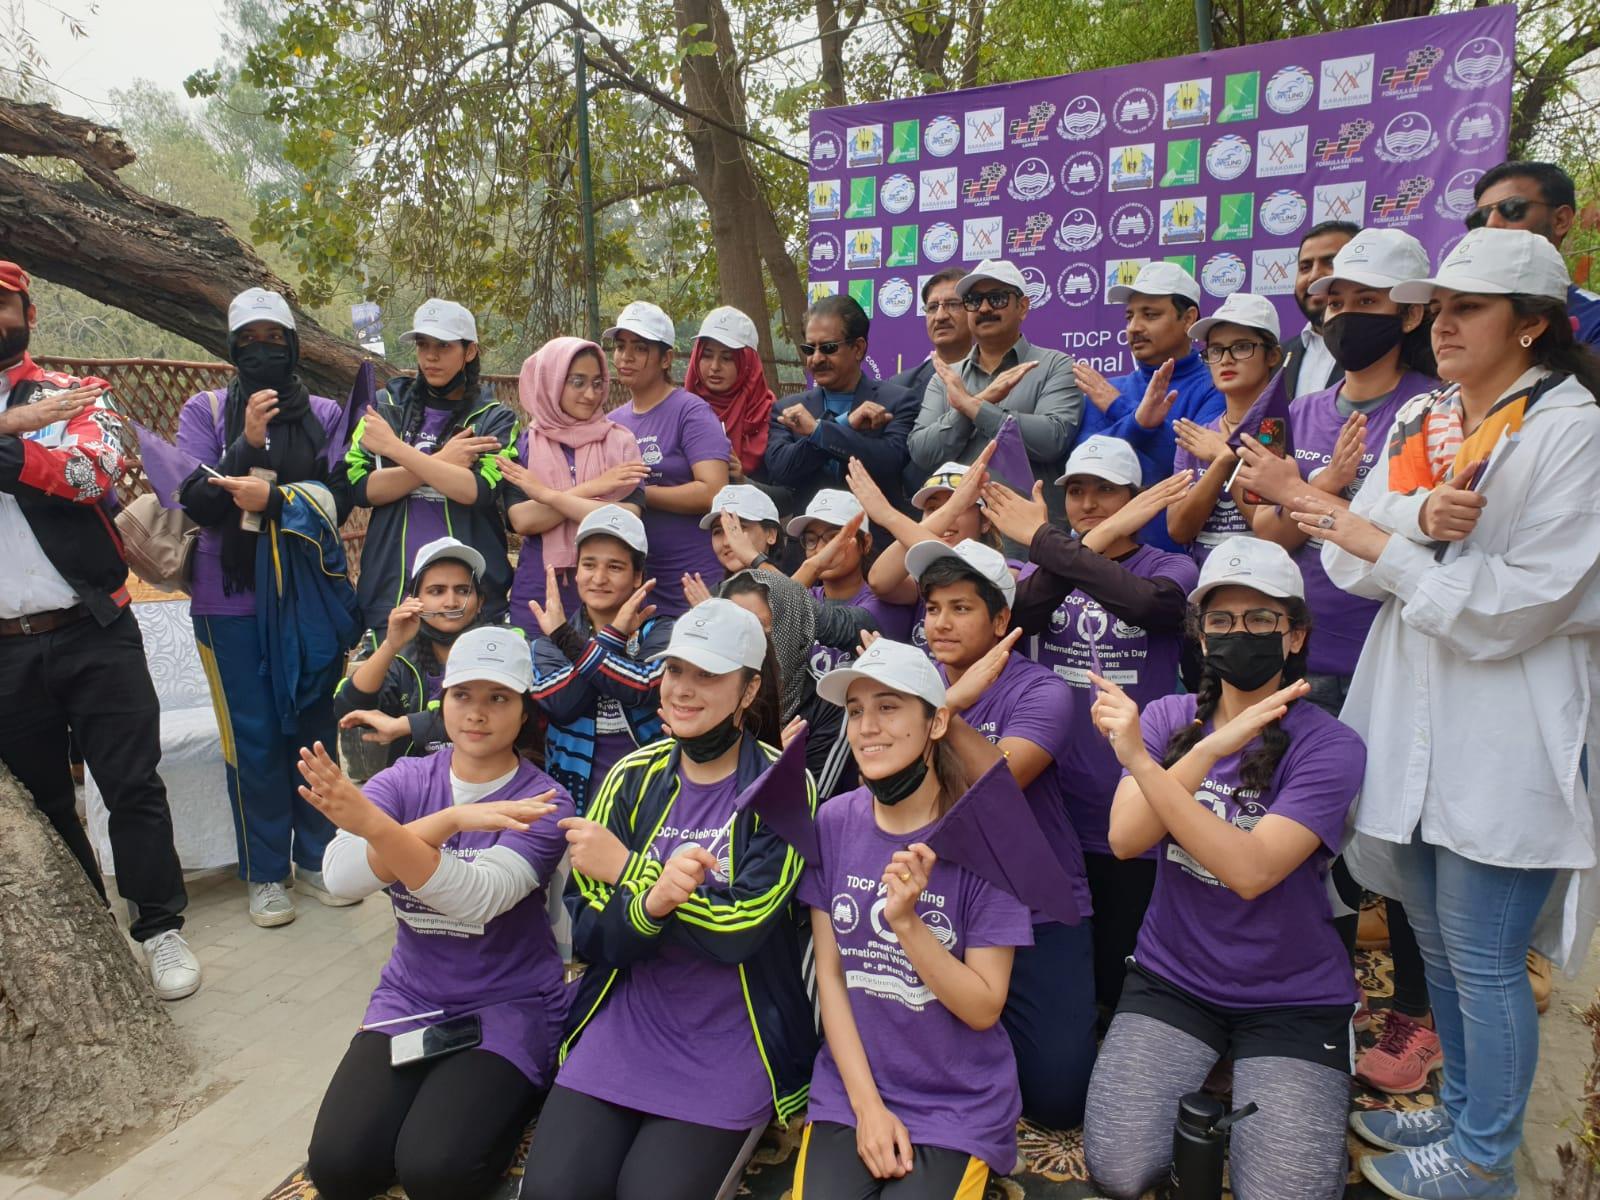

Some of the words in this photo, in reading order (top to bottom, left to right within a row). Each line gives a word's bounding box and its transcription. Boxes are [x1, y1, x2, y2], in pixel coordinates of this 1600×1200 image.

[1061, 331, 1112, 348] TDCP
[1065, 595, 1085, 605] DCP
[1044, 641, 1090, 657] International
[1094, 648, 1129, 658] omen's
[1131, 649, 1148, 659] Day
[656, 827, 679, 838] DCP
[847, 875, 876, 891] TDCP
